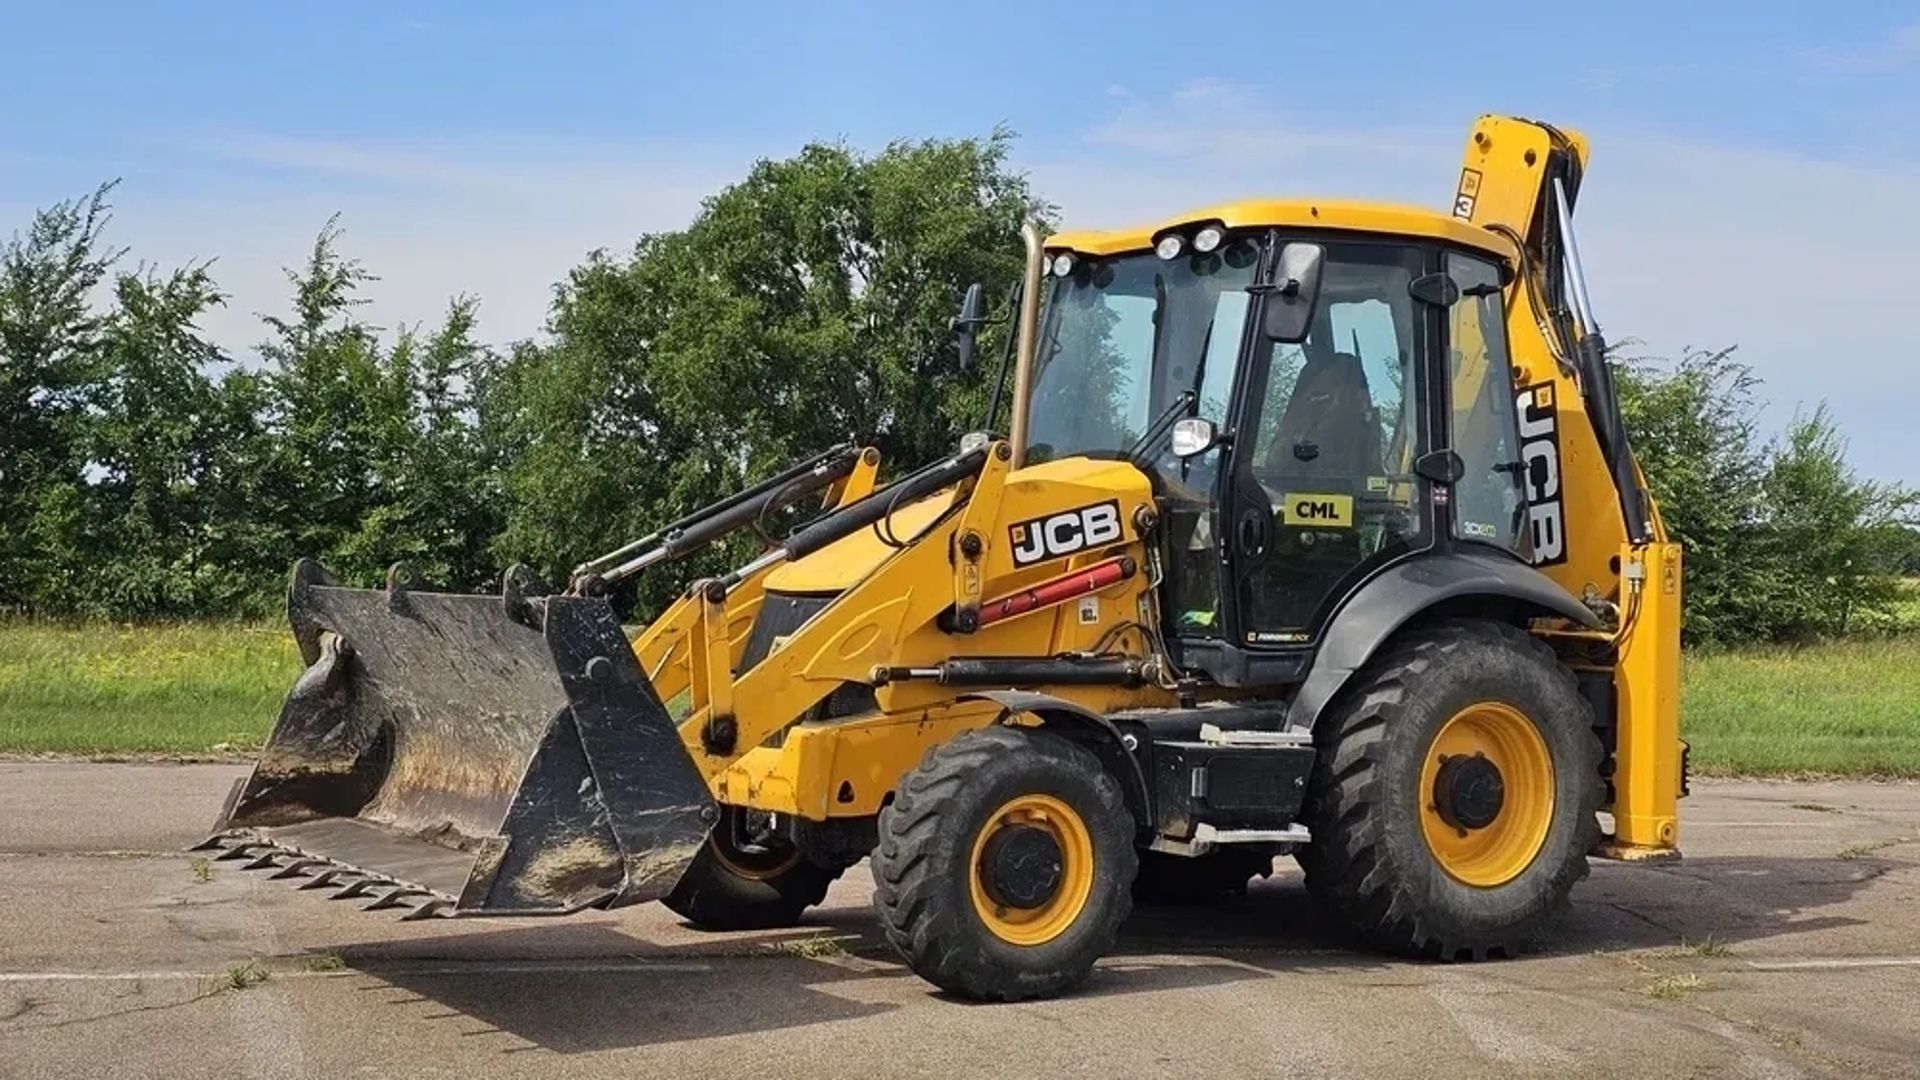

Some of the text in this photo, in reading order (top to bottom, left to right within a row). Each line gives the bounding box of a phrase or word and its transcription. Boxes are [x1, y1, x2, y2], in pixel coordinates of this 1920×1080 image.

[1516, 391, 1563, 564] JCB
[1015, 504, 1120, 563] JCB
[1296, 501, 1339, 519] CML
